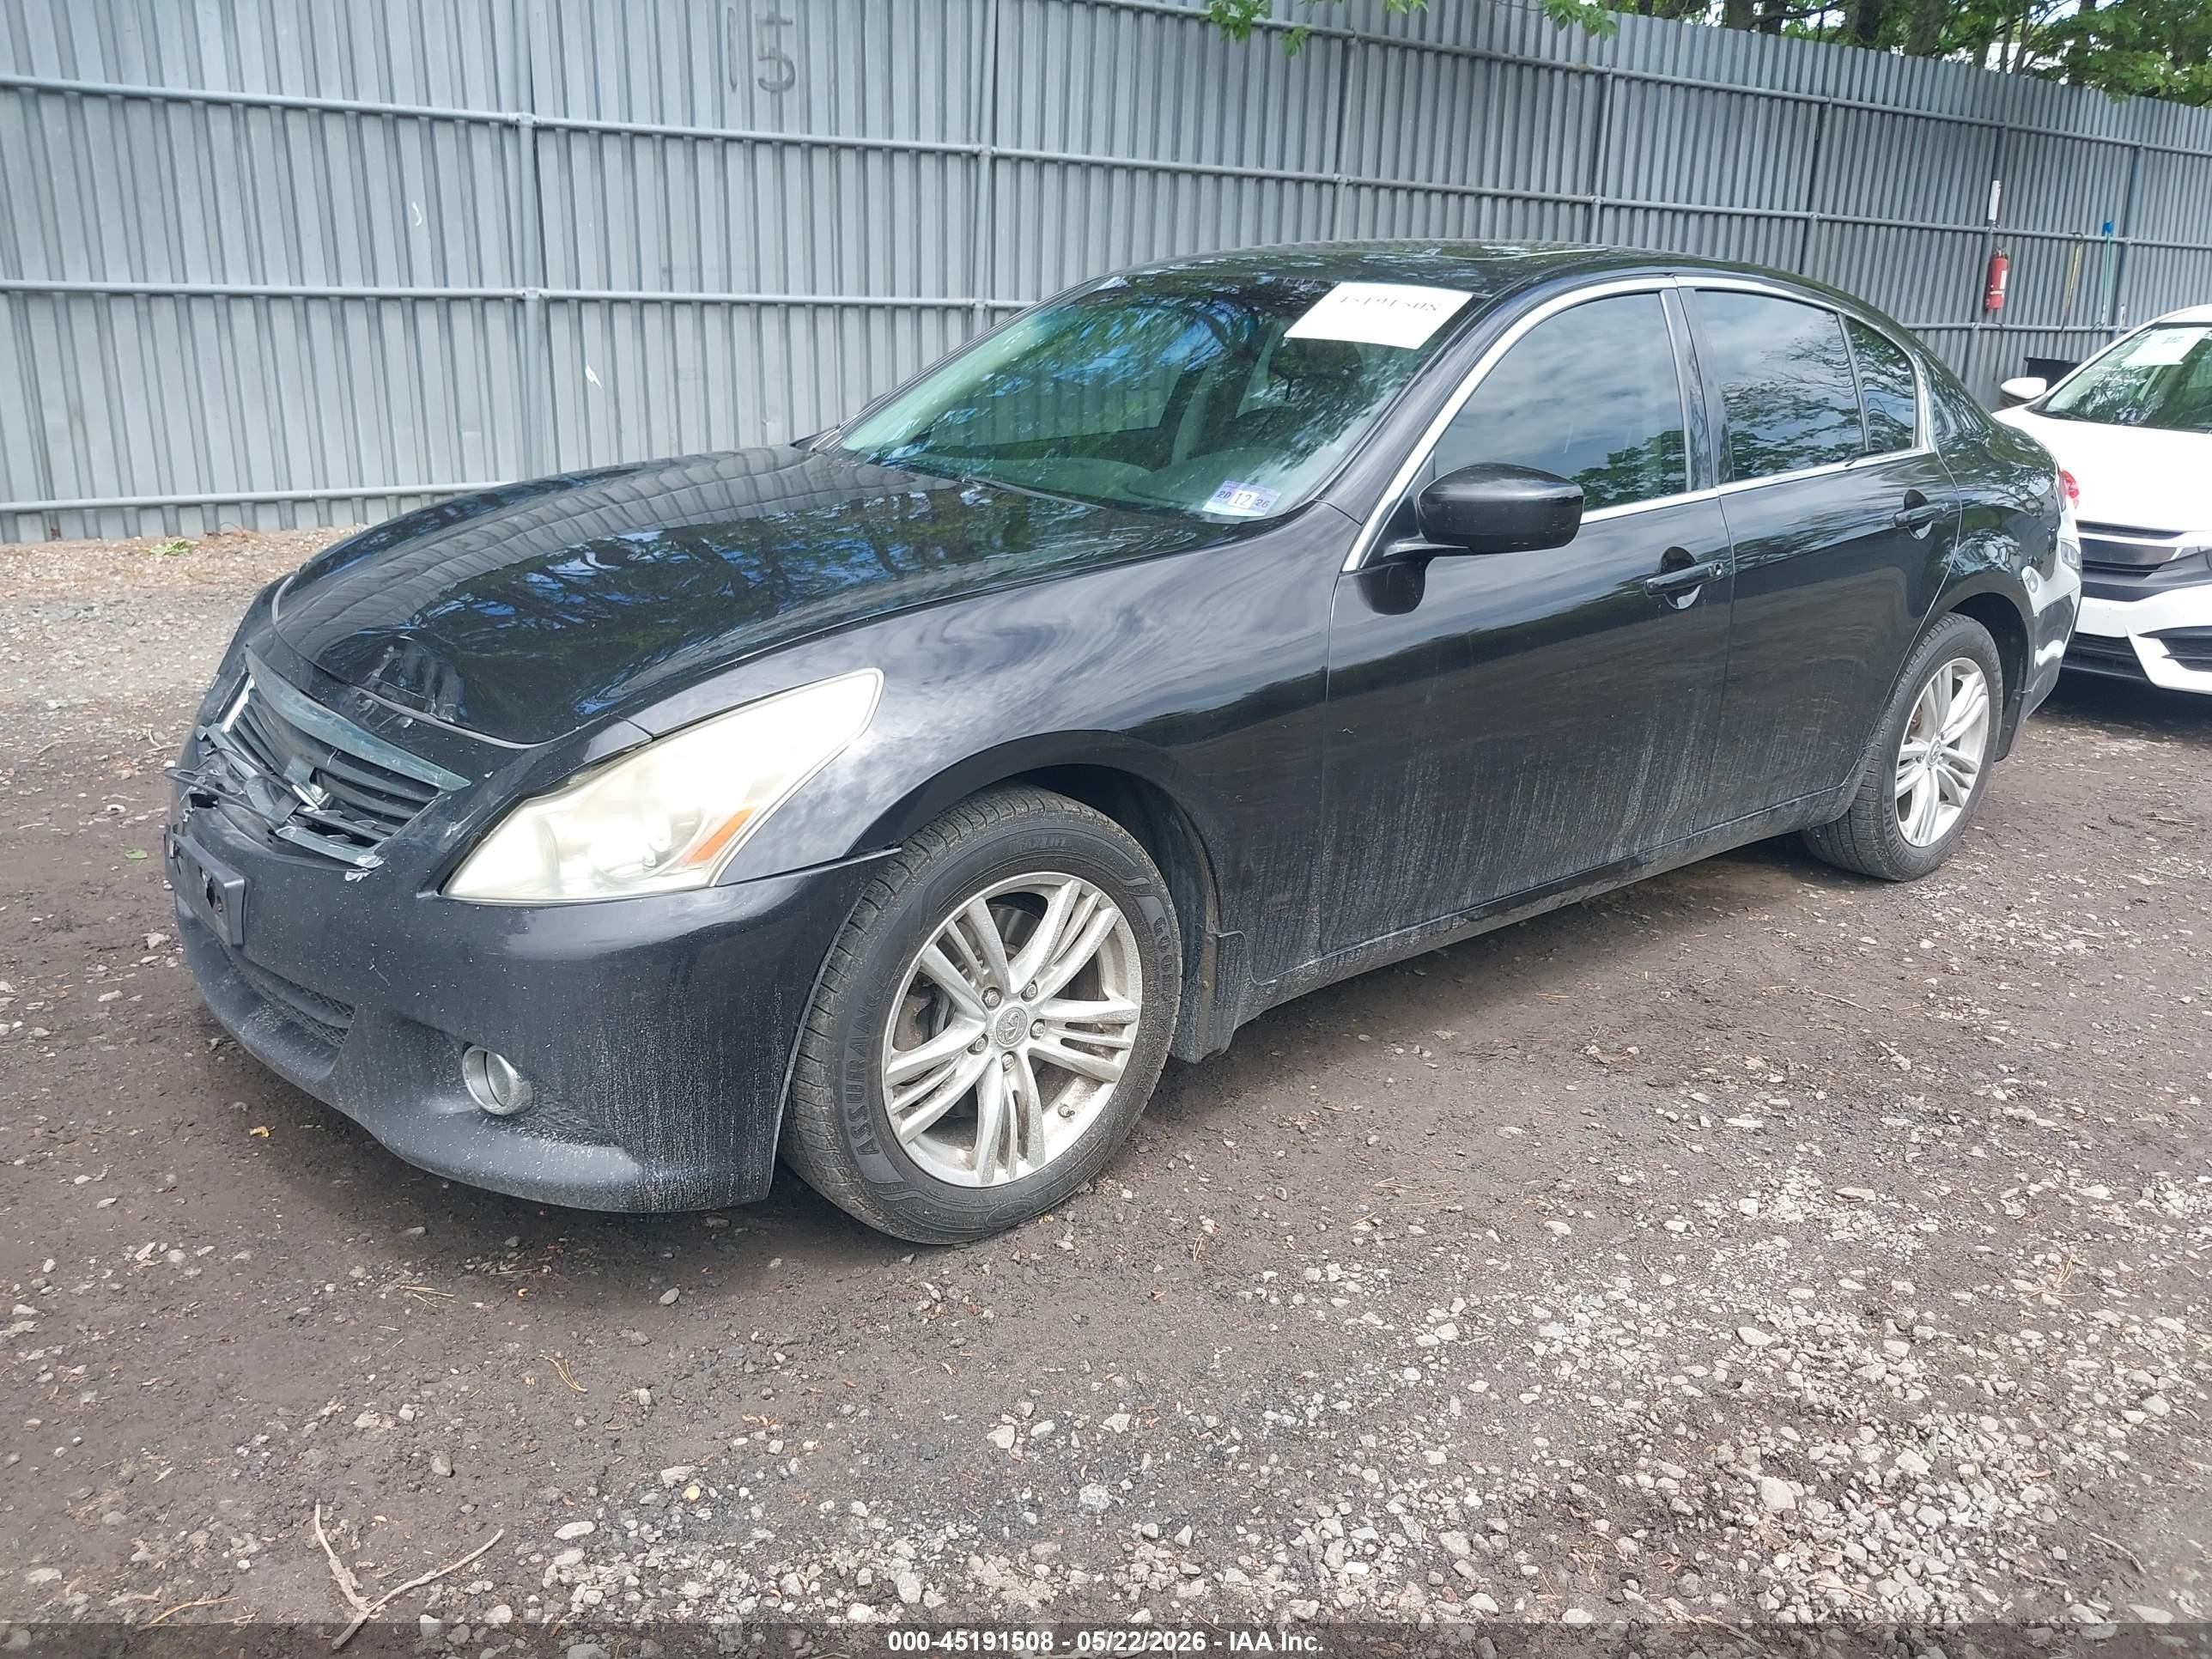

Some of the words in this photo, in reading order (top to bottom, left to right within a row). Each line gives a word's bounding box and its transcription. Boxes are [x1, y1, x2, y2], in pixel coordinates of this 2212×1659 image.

[726, 7, 796, 94] 15
[1217, 490, 1232, 499] 20
[1233, 493, 1253, 506] 12
[1255, 499, 1270, 508] 26
